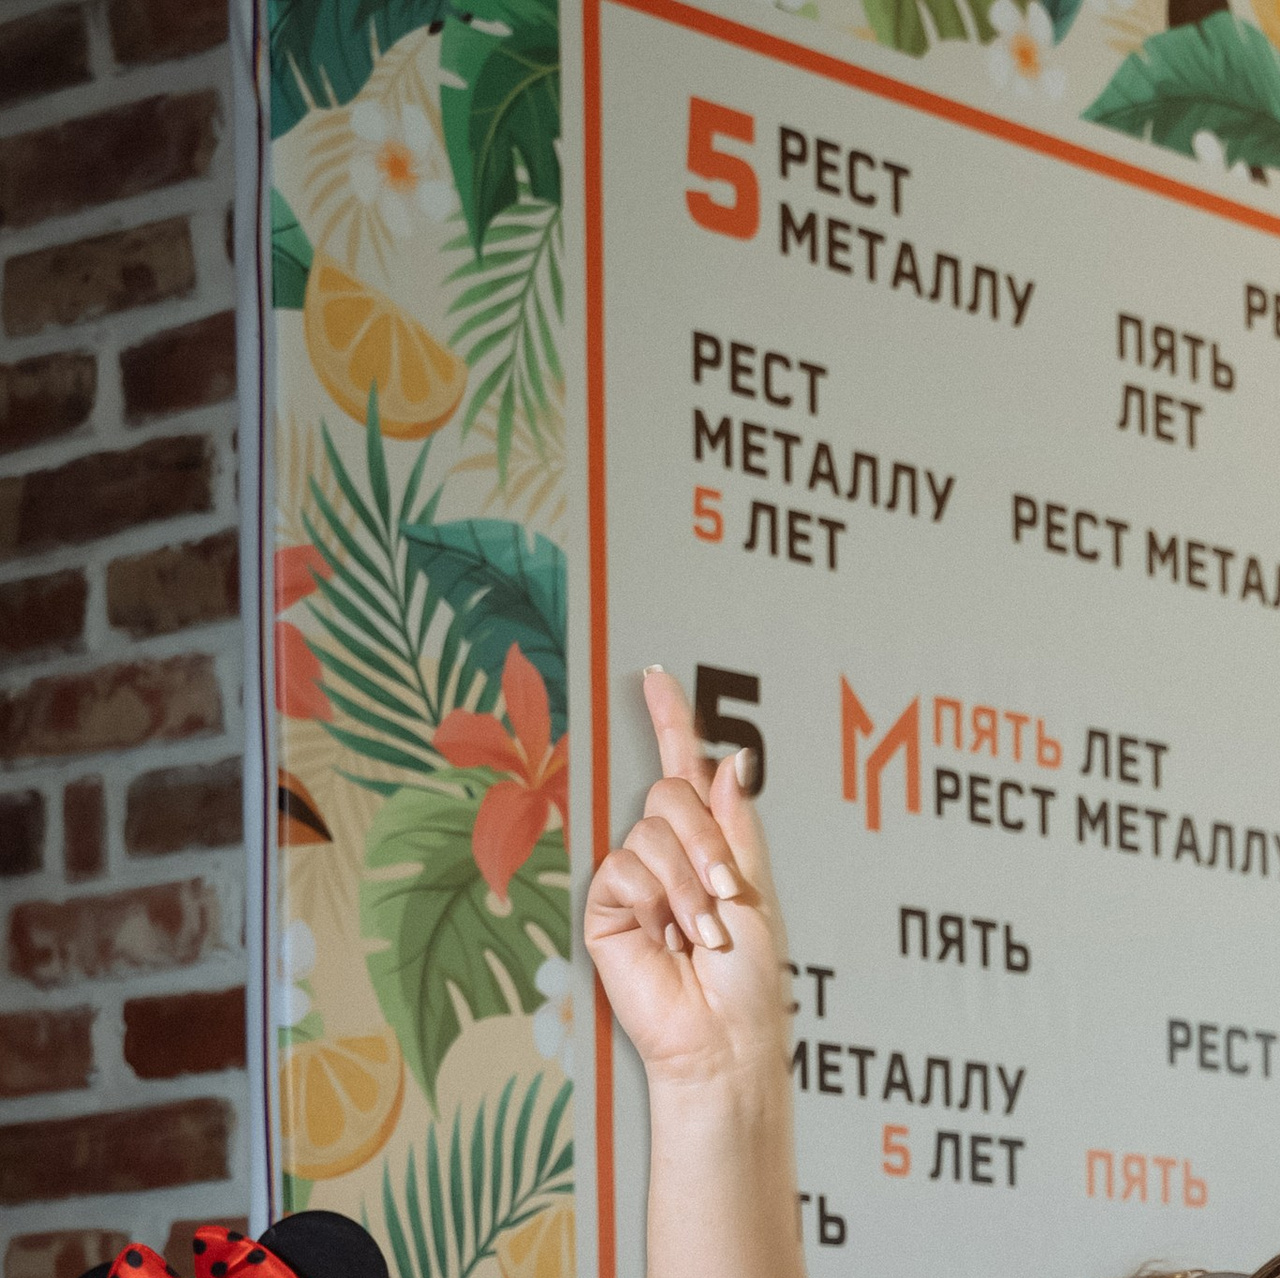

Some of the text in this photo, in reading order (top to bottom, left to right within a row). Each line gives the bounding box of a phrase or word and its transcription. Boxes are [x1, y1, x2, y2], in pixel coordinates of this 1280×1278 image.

[685, 96, 760, 241] 5
[778, 122, 910, 216] РЕСТ
[779, 201, 1036, 328] МЕТАЛЛУ
[692, 330, 829, 416] РЕСТ
[1117, 311, 1237, 393] ПЯТЬ
[1117, 383, 1205, 450] ЛЕТ
[692, 408, 956, 523] МЕТАЛЛУ
[692, 486, 847, 572] 5 ЛЕТ
[1012, 494, 1130, 568] РЕСТ
[932, 696, 1170, 790] ПЯТЬ ЛЕТ
[932, 768, 1056, 837] РЕСТ
[899, 906, 1032, 975] ПЯТЬ
[1168, 1018, 1278, 1078] РЕСТ
[882, 1124, 1025, 1187] 5 ЛЕТ
[1086, 1149, 1209, 1208] ПЯТЬ
